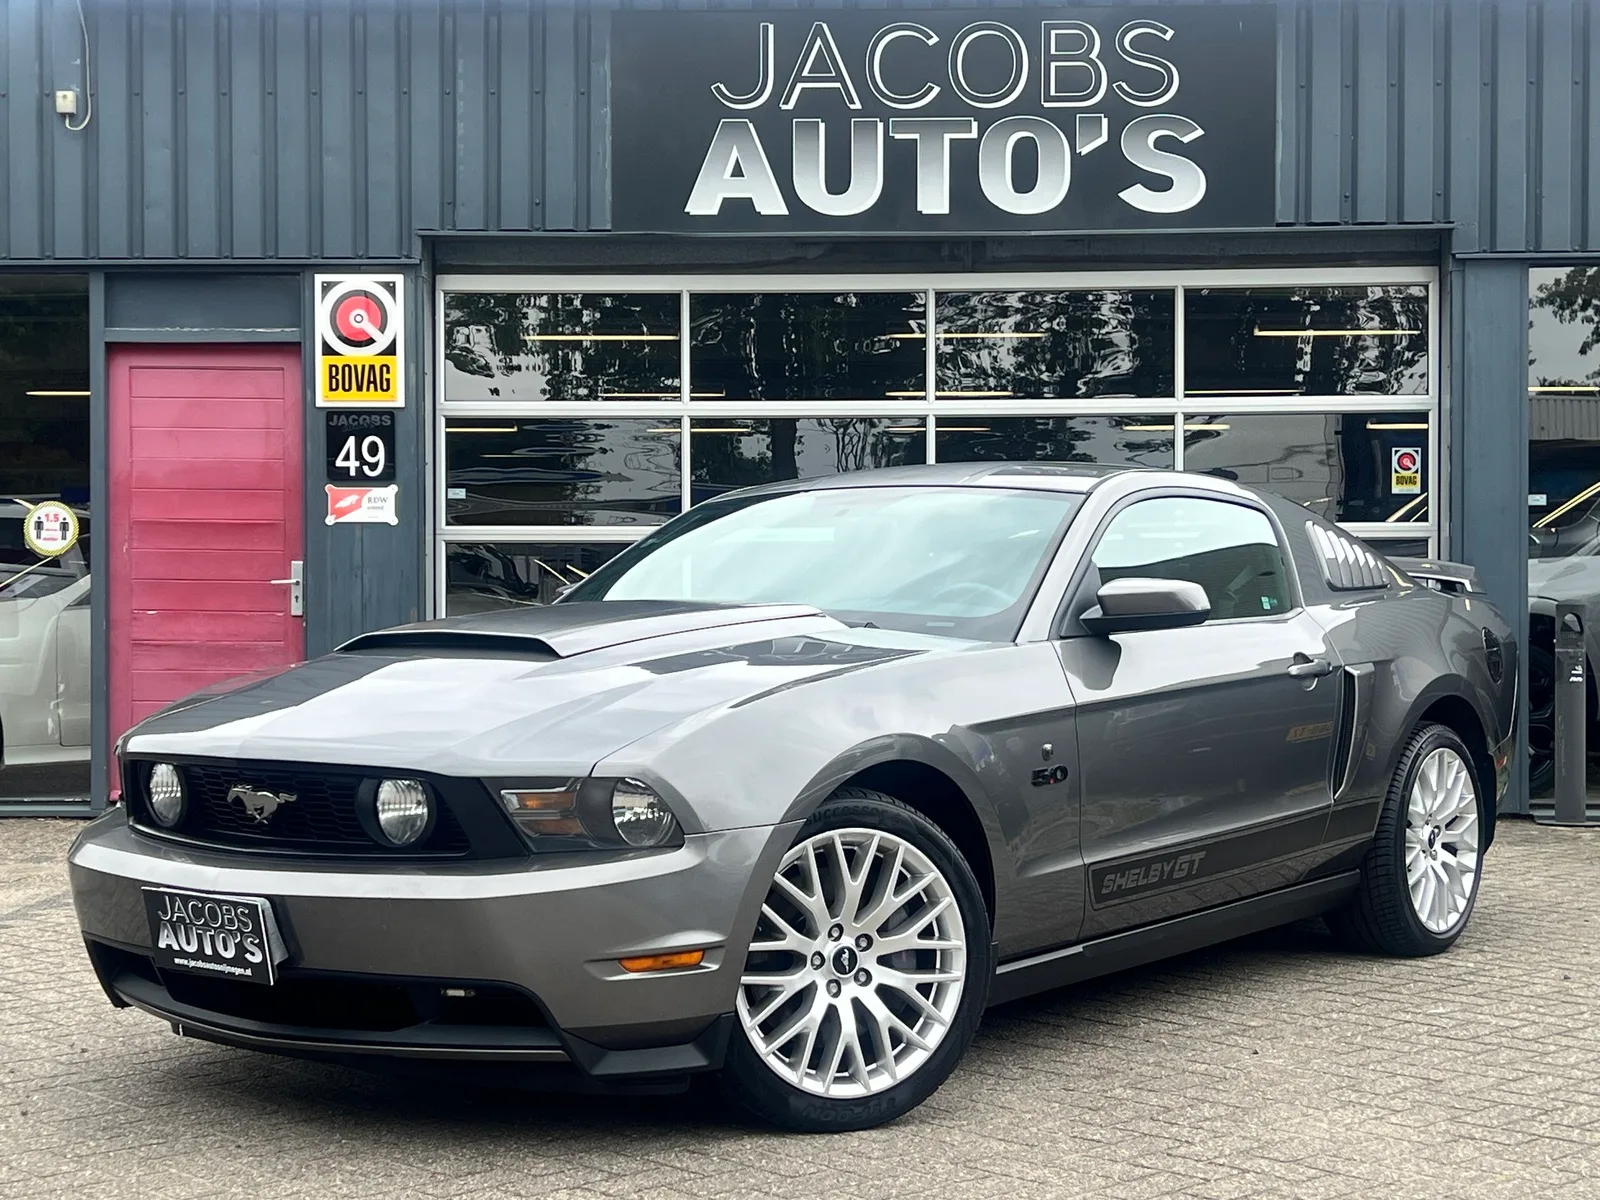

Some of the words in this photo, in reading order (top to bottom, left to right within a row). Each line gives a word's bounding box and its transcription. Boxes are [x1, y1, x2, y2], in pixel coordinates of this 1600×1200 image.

[710, 20, 1180, 110] JACOBS
[684, 113, 1207, 216] AUTO'S
[327, 363, 391, 393] BOVAG
[328, 414, 392, 427] JACOBS
[335, 435, 385, 477] 49
[1396, 475, 1417, 485] BOVAG
[367, 496, 389, 504] RDW
[44, 513, 60, 522] 1.5
[1031, 764, 1069, 787] 5.0
[157, 895, 253, 932] JACOBS
[158, 922, 262, 962] AUTO'S
